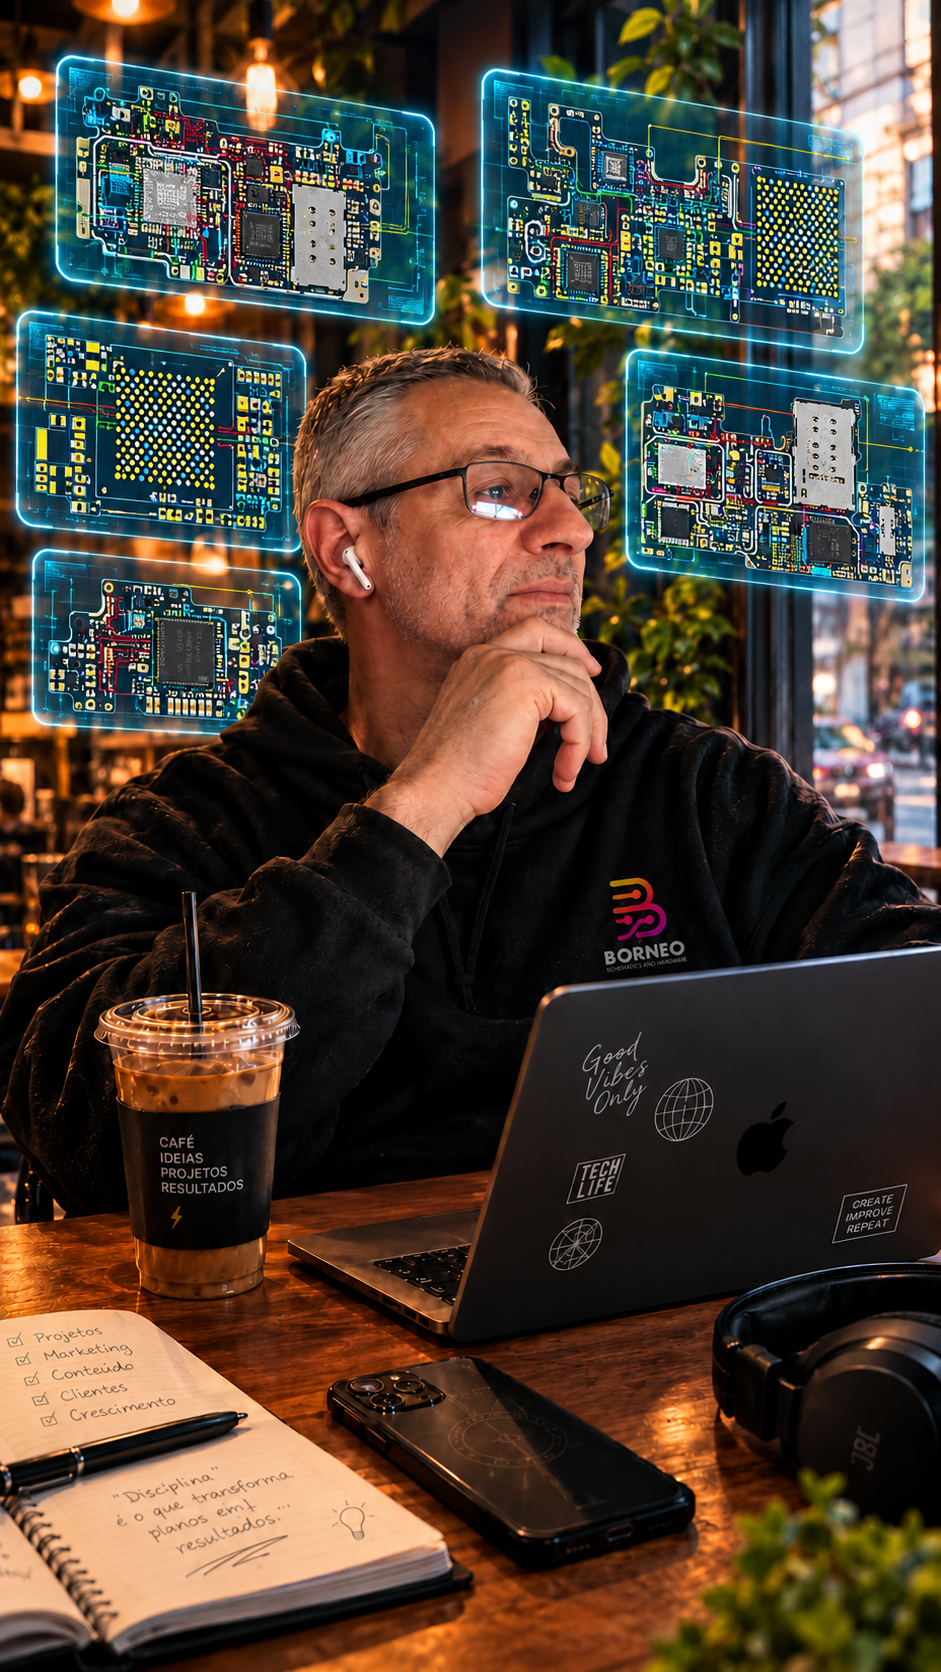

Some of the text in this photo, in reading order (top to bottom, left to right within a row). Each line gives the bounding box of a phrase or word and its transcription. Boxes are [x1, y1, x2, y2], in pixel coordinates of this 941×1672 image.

[603, 940, 686, 966] BORNEO
[582, 1031, 642, 1075] Good
[585, 1058, 649, 1101] Vibes
[593, 1078, 648, 1117] Only
[159, 1134, 195, 1149] CAFÉ
[160, 1152, 204, 1165] IDEIAS
[582, 1157, 621, 1181] TECH
[160, 1165, 228, 1179] PROJETOS
[161, 1178, 244, 1195] RESULTADOS
[576, 1175, 616, 1199] LIFE
[852, 1193, 895, 1210] CREATE
[845, 1205, 894, 1223] IMPROVE
[846, 1218, 890, 1234] REPEAT
[33, 1326, 104, 1344] Projetos
[43, 1341, 133, 1362] Marketing
[51, 1361, 135, 1382] Conteúdo
[60, 1382, 129, 1403] Clientes
[69, 1396, 177, 1422] Crescimento
[850, 1425, 881, 1471] JBL
[116, 1471, 295, 1528] é o que transforma
[148, 1513, 209, 1543] planos
